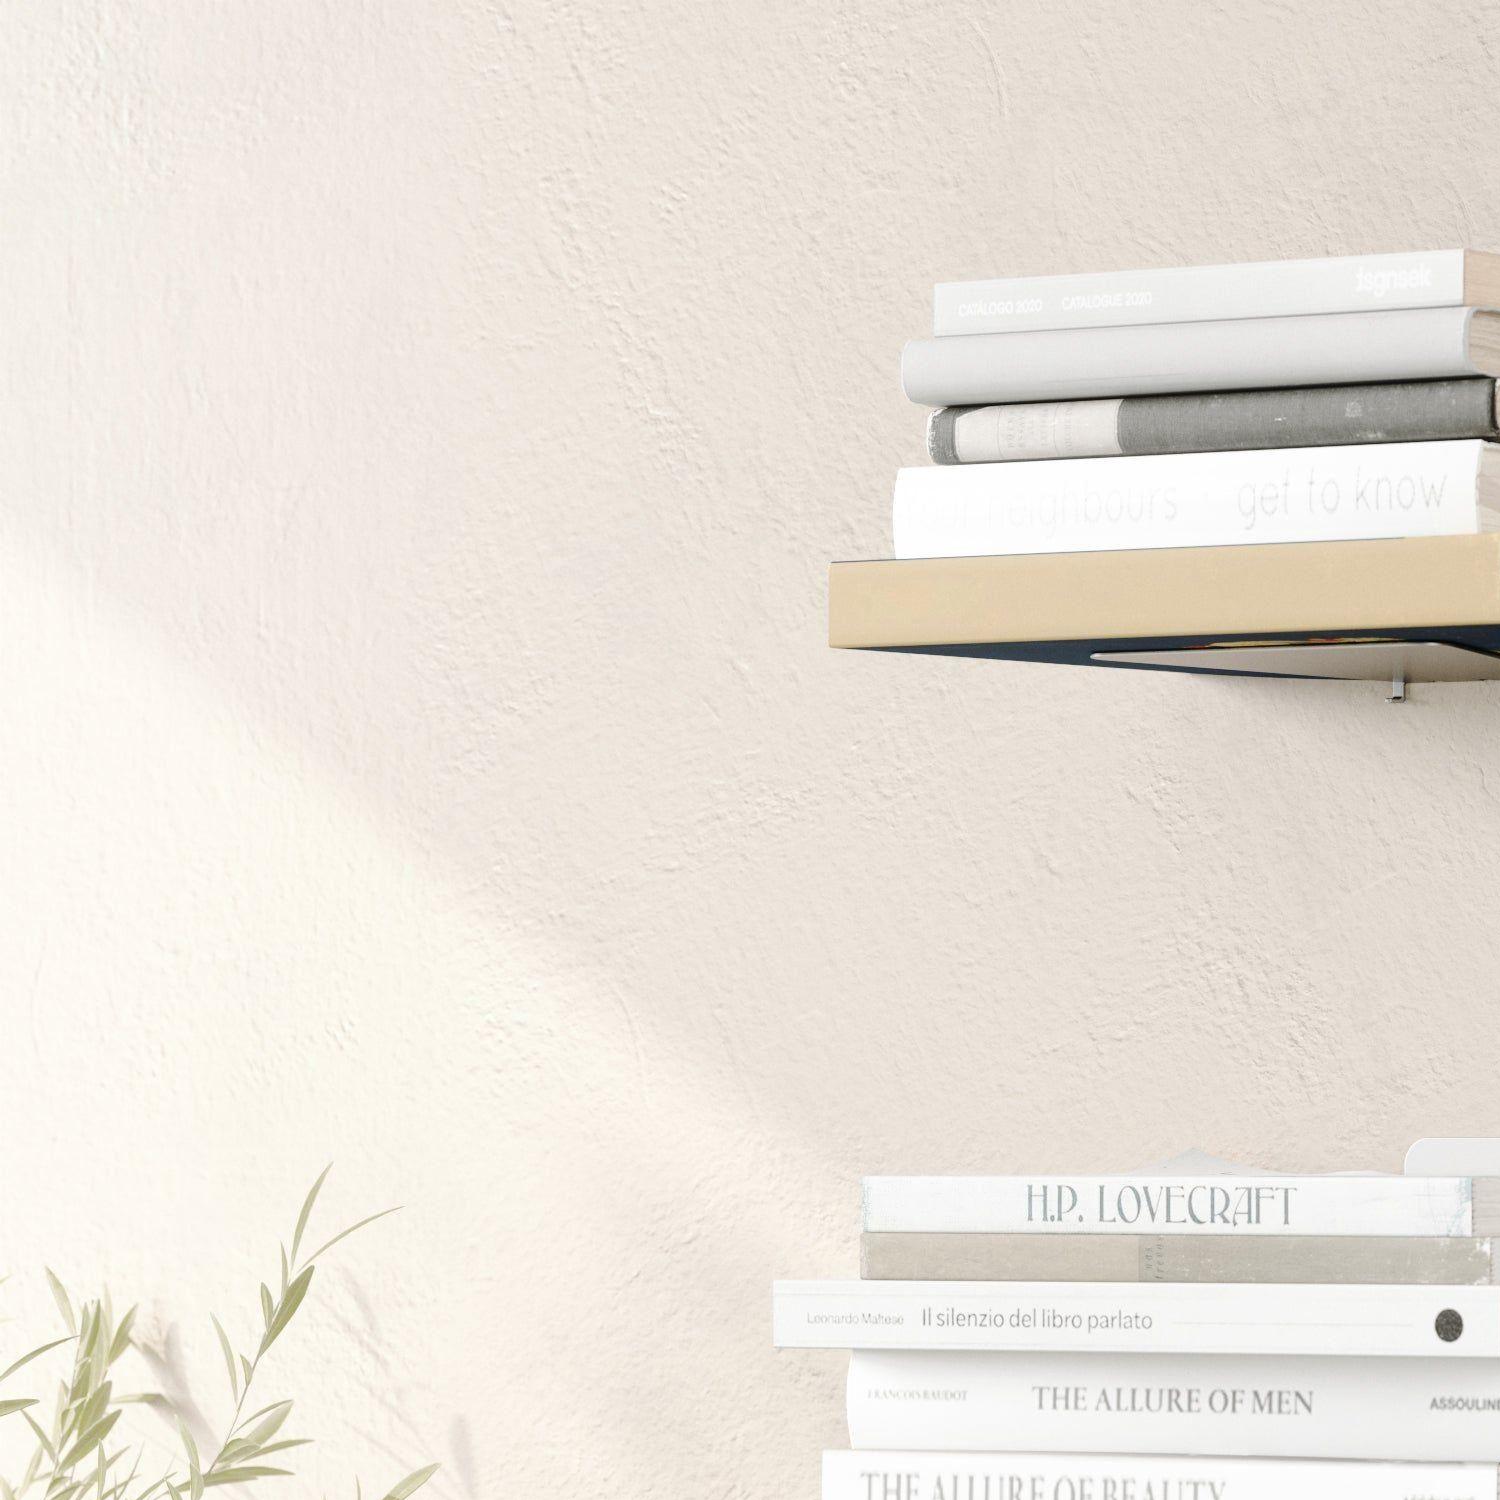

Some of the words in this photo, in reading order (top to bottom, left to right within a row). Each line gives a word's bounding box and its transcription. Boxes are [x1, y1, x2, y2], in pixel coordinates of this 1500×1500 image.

[1061, 293, 1123, 311] CATALOGUE
[1125, 291, 1153, 307] 2020
[1237, 466, 1294, 531] get
[1307, 465, 1341, 515] to
[1353, 464, 1452, 512] know
[1026, 1184, 1084, 1222] H.P.
[1098, 1183, 1298, 1228] LOVECRAFT
[806, 1311, 860, 1326] Leonardo
[935, 1306, 1005, 1329] silenzio
[1008, 1307, 1037, 1330] del
[1041, 1308, 1083, 1330] libro
[1087, 1309, 1154, 1335] parlato
[1032, 1385, 1088, 1412] THE
[1094, 1386, 1203, 1415] ALLURE
[1208, 1388, 1246, 1416] OF
[1250, 1388, 1315, 1416] MEN
